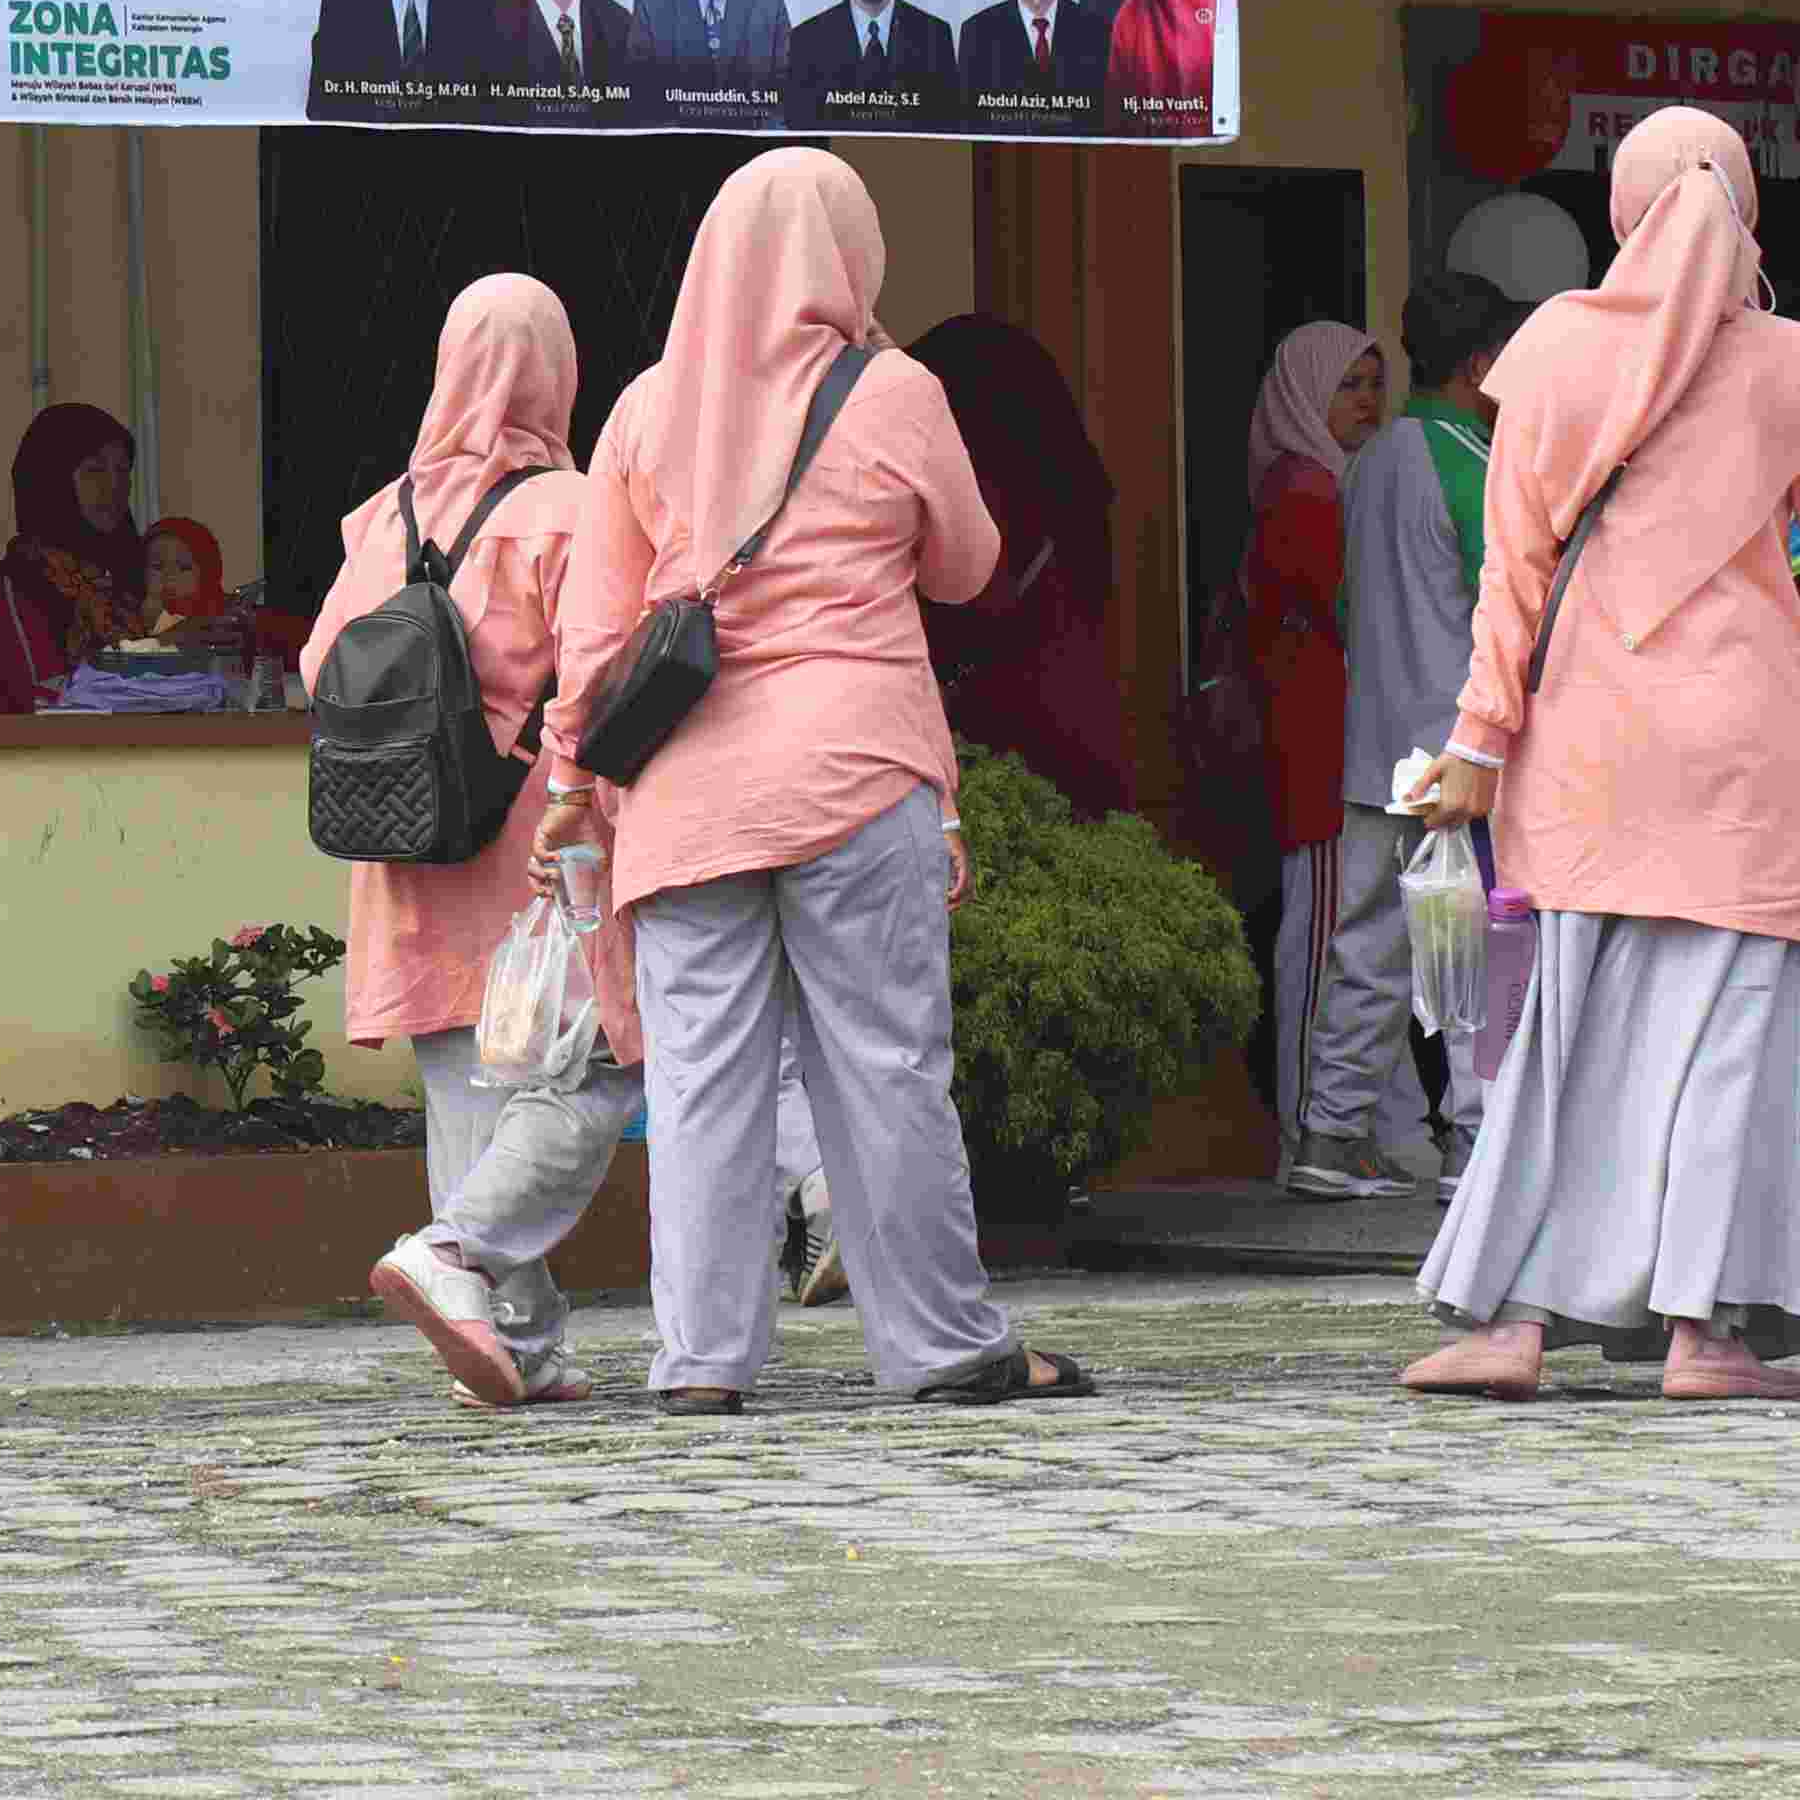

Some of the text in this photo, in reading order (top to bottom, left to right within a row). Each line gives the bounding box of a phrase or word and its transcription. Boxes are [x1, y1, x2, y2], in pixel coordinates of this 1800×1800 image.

[8, 0, 119, 36] ZONA
[9, 41, 232, 81] INTEGRITAS
[323, 80, 344, 94] Dr.
[345, 80, 359, 94] H.
[489, 84, 505, 97] H.
[506, 83, 565, 99] Amrizal,
[605, 86, 631, 100] MM
[824, 90, 921, 107] Abdel Aziz, S.E
[977, 94, 1018, 108] Abdul
[1019, 95, 1050, 110] Aziz,
[1123, 96, 1209, 114] Hj. Ida Yanti,
